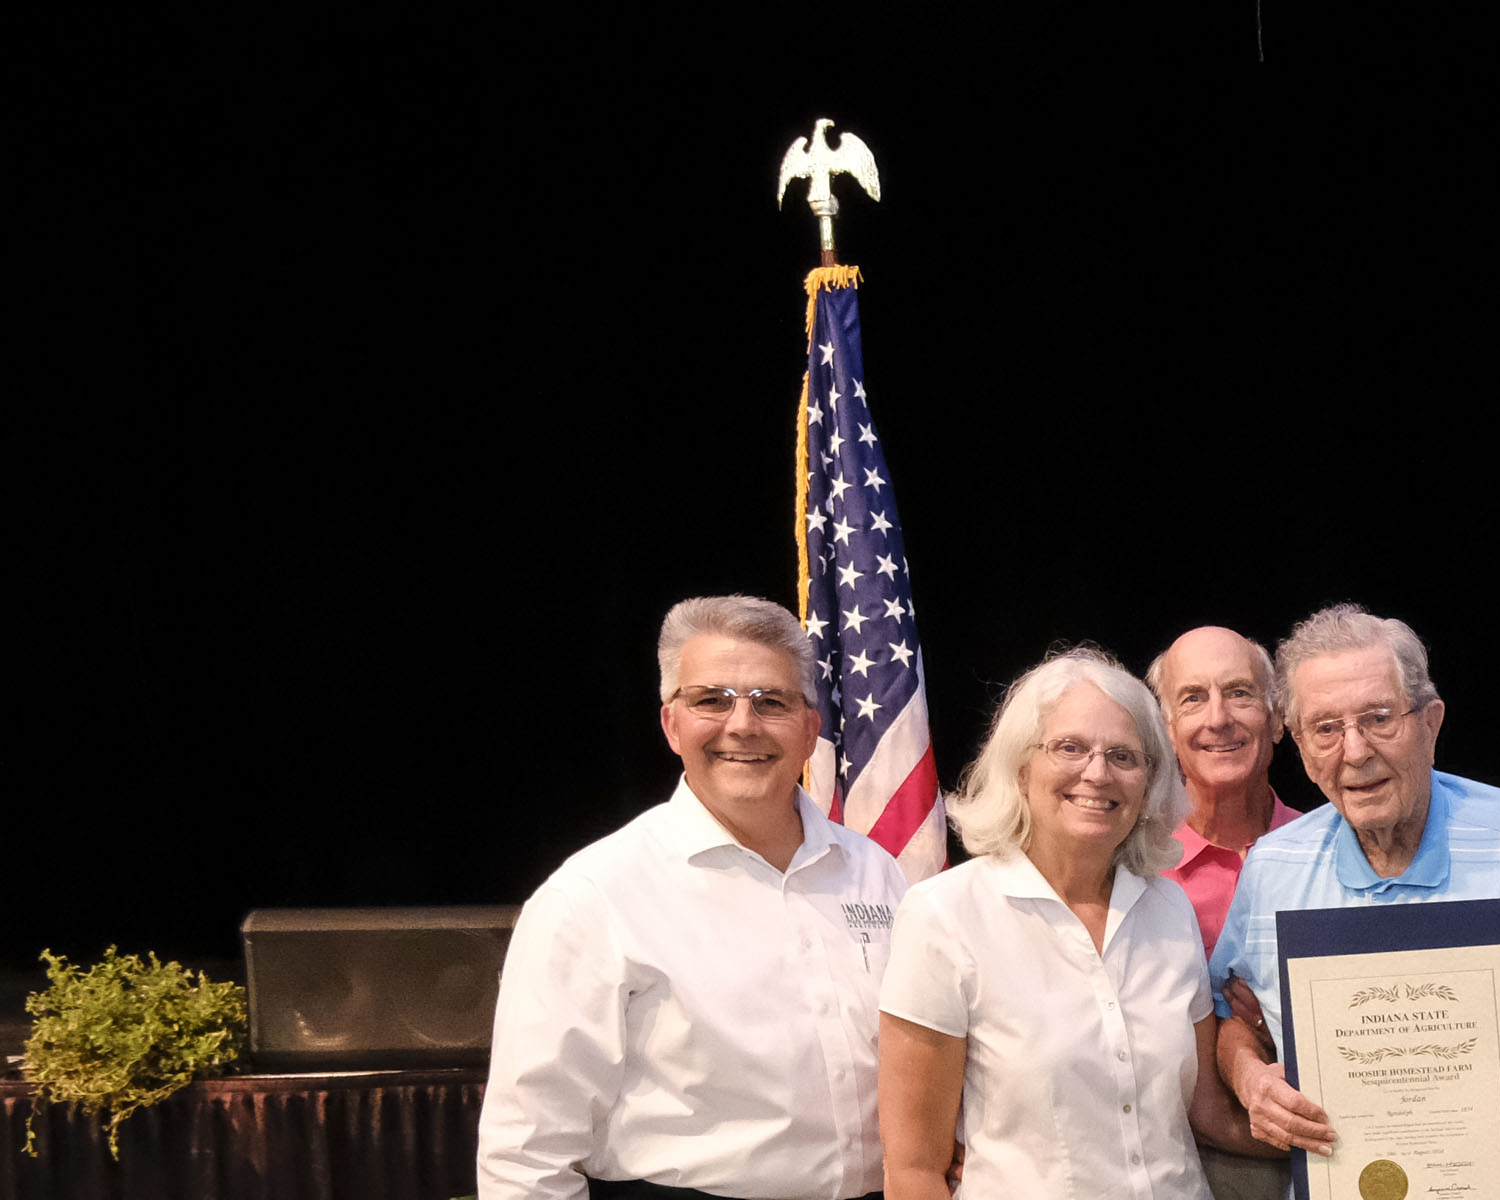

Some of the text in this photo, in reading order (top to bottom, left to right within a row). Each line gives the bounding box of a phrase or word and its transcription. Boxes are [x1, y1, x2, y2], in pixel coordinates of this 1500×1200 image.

[841, 903, 895, 921] INDIANA
[1361, 1009, 1449, 1024] INDIANA STATE
[1335, 1026, 1395, 1037] DEPARTMENT
[1413, 1021, 1478, 1033] AGRICULTURE
[1348, 1064, 1473, 1079] HOOSIER HOMESTEAD FARM
[1432, 1073, 1460, 1081] Award
